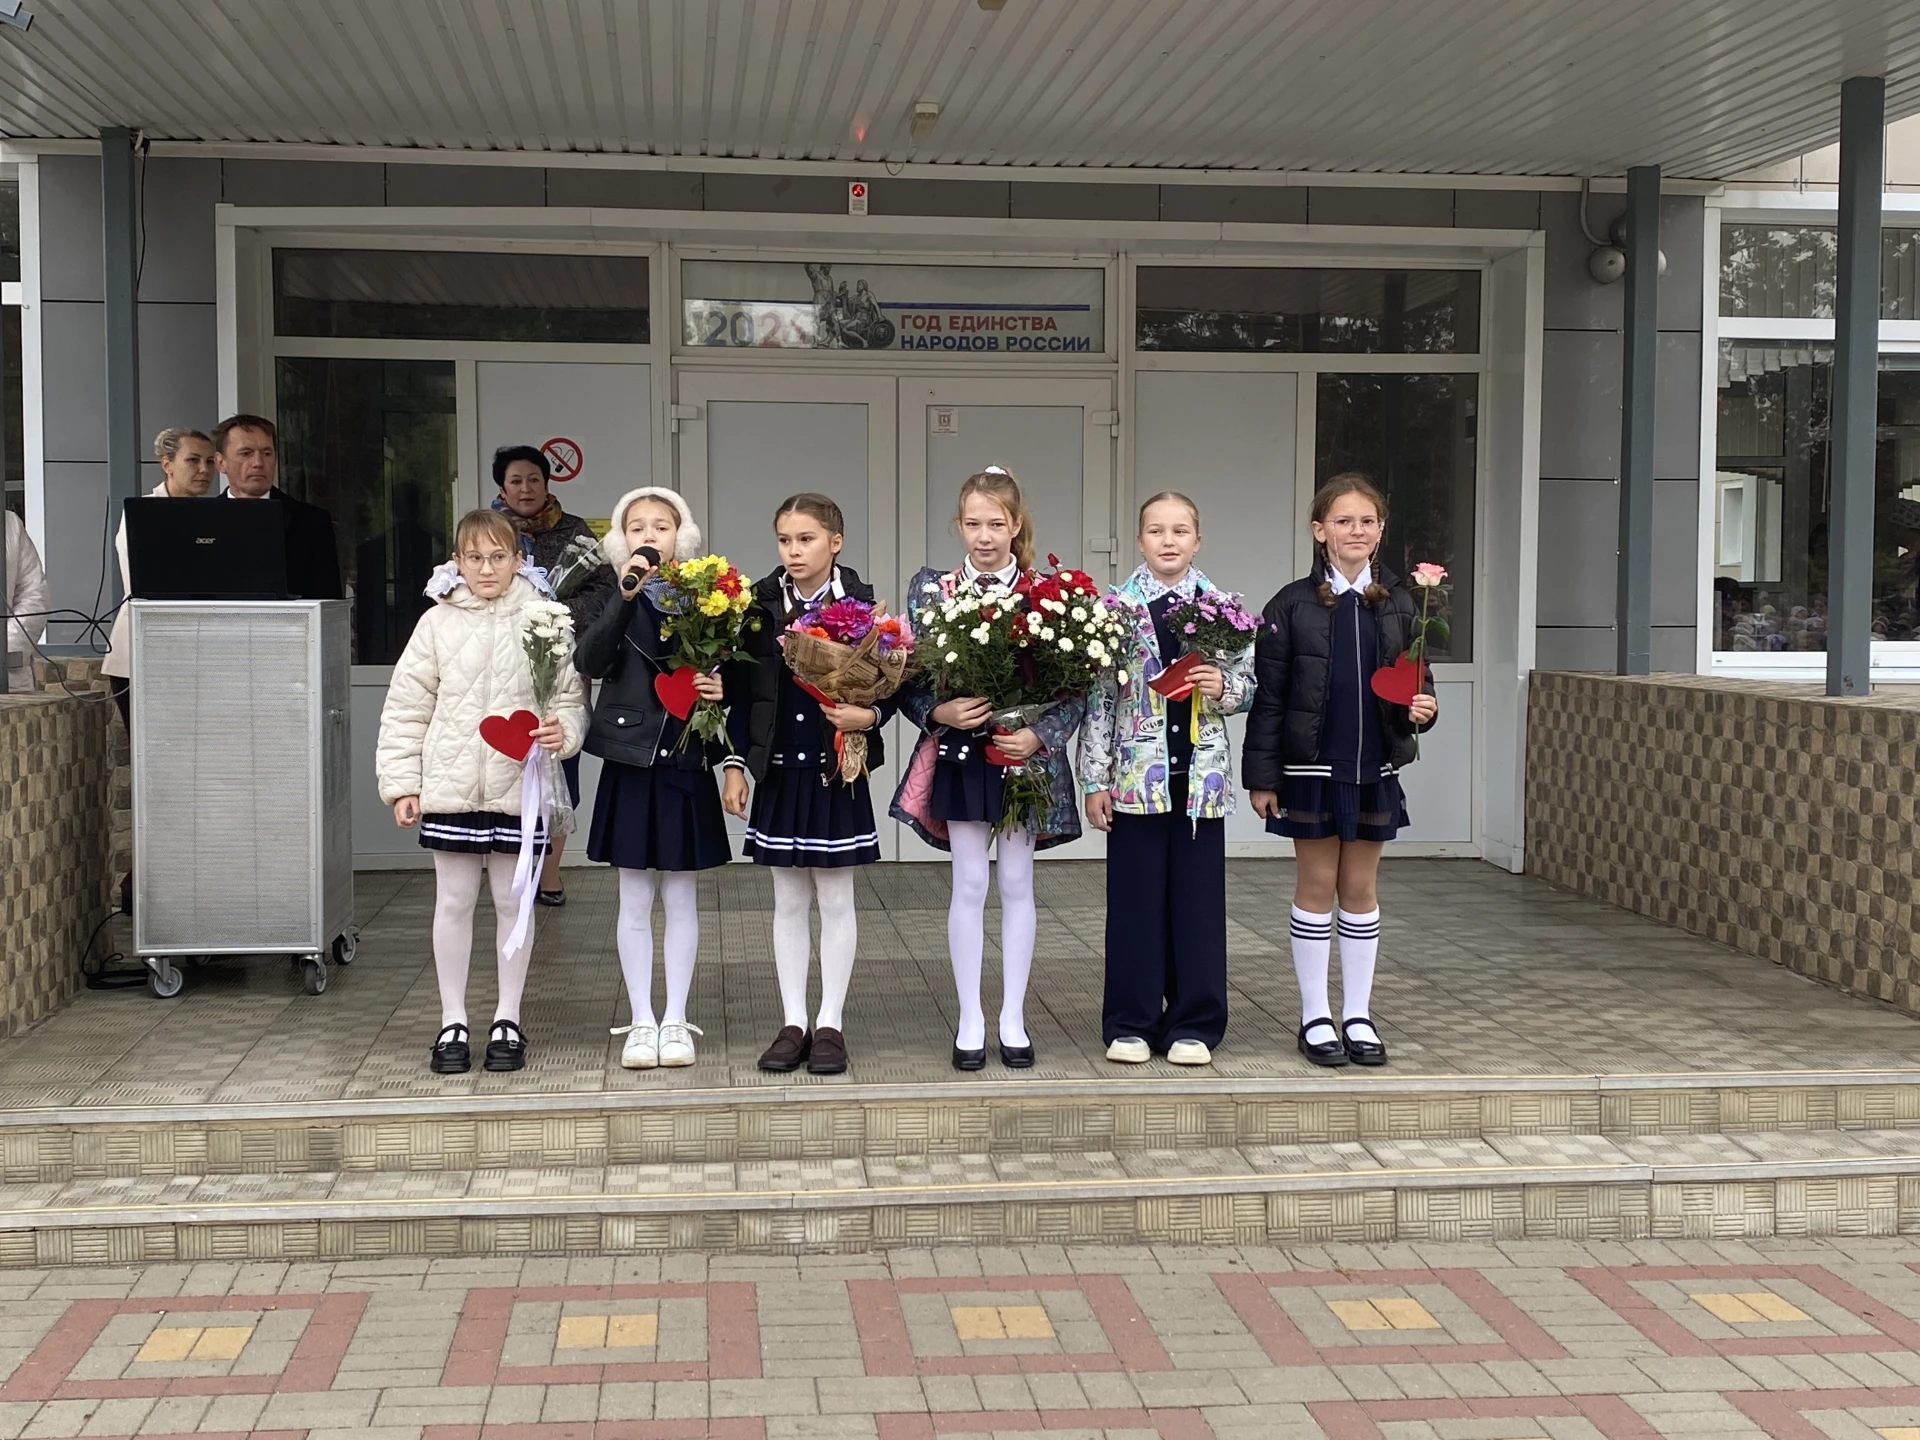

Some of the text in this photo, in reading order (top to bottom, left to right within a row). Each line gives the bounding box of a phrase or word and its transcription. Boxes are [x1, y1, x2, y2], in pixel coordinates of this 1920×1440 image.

[901, 315, 1058, 333] ГОД ЕДИНСТВА
[901, 335, 1091, 351] НАРОДОВ РОССИИ
